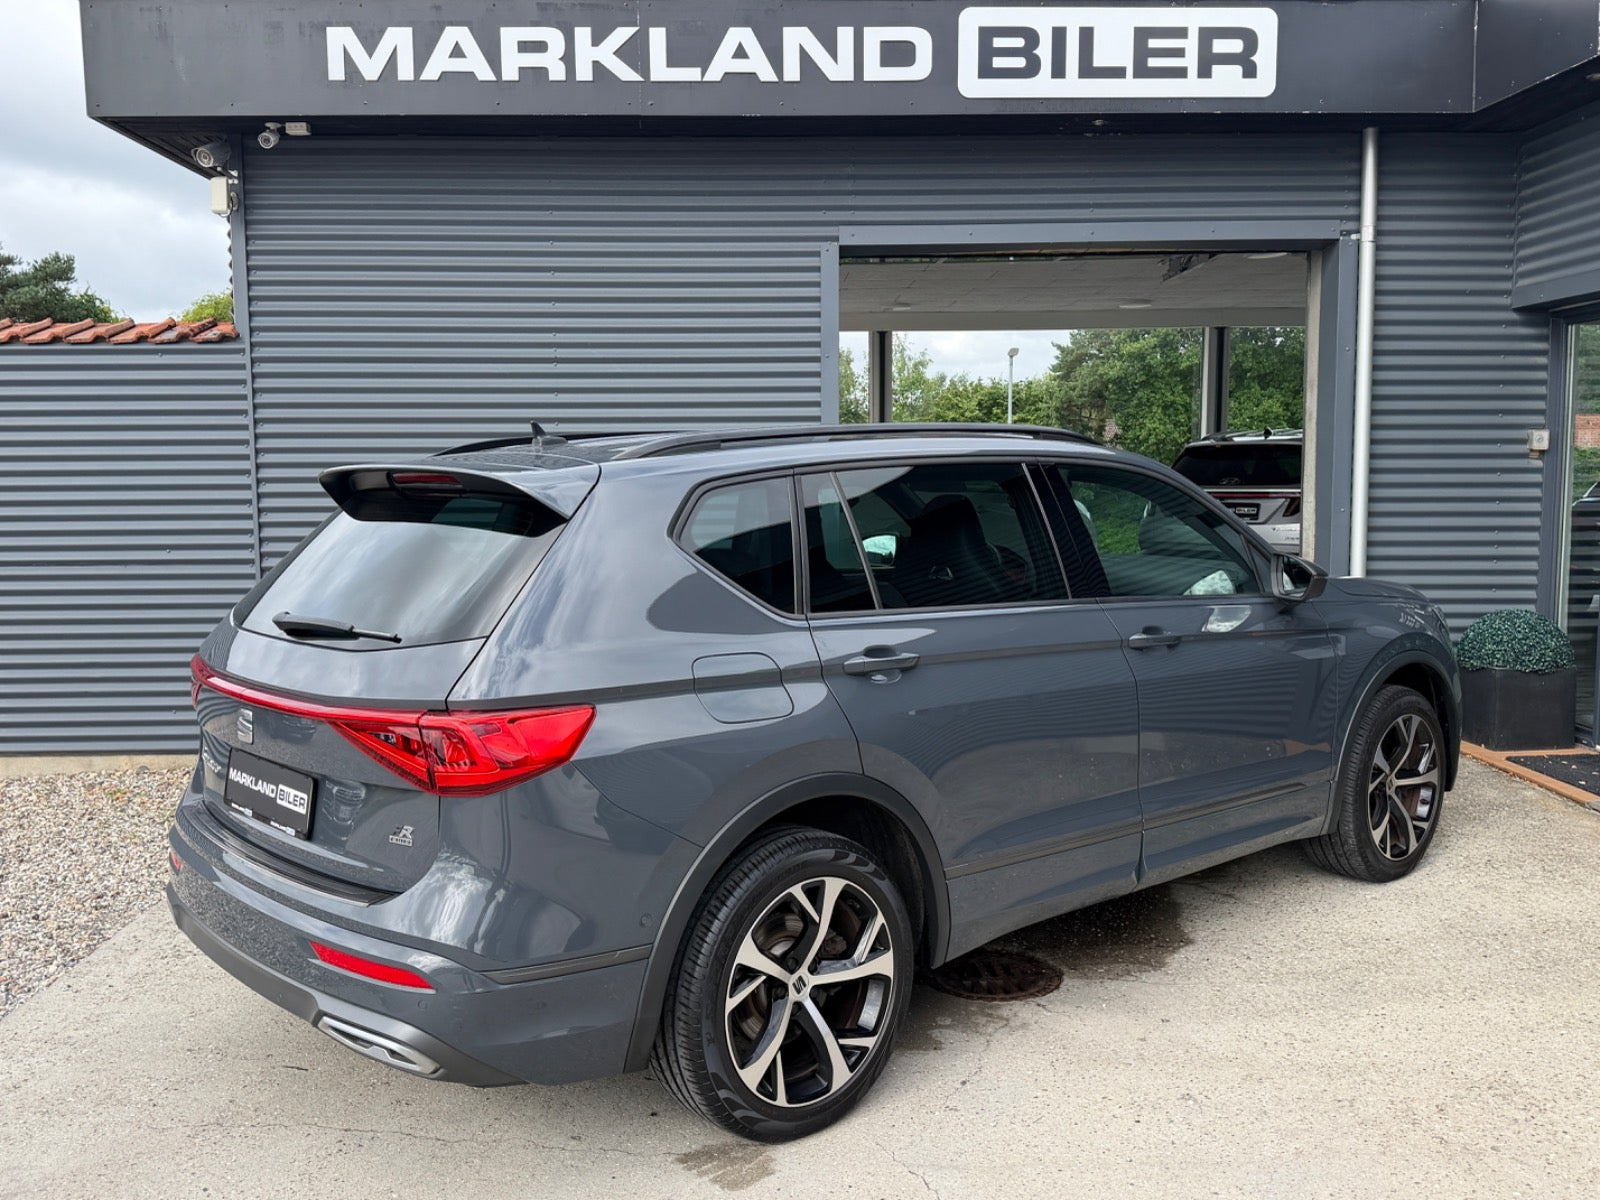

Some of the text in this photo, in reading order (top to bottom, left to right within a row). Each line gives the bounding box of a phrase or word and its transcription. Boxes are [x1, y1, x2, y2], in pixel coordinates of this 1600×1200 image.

[326, 26, 1258, 83] MARKLAND BILER
[229, 767, 277, 798] MARKLAND
[278, 788, 306, 811] BILER
